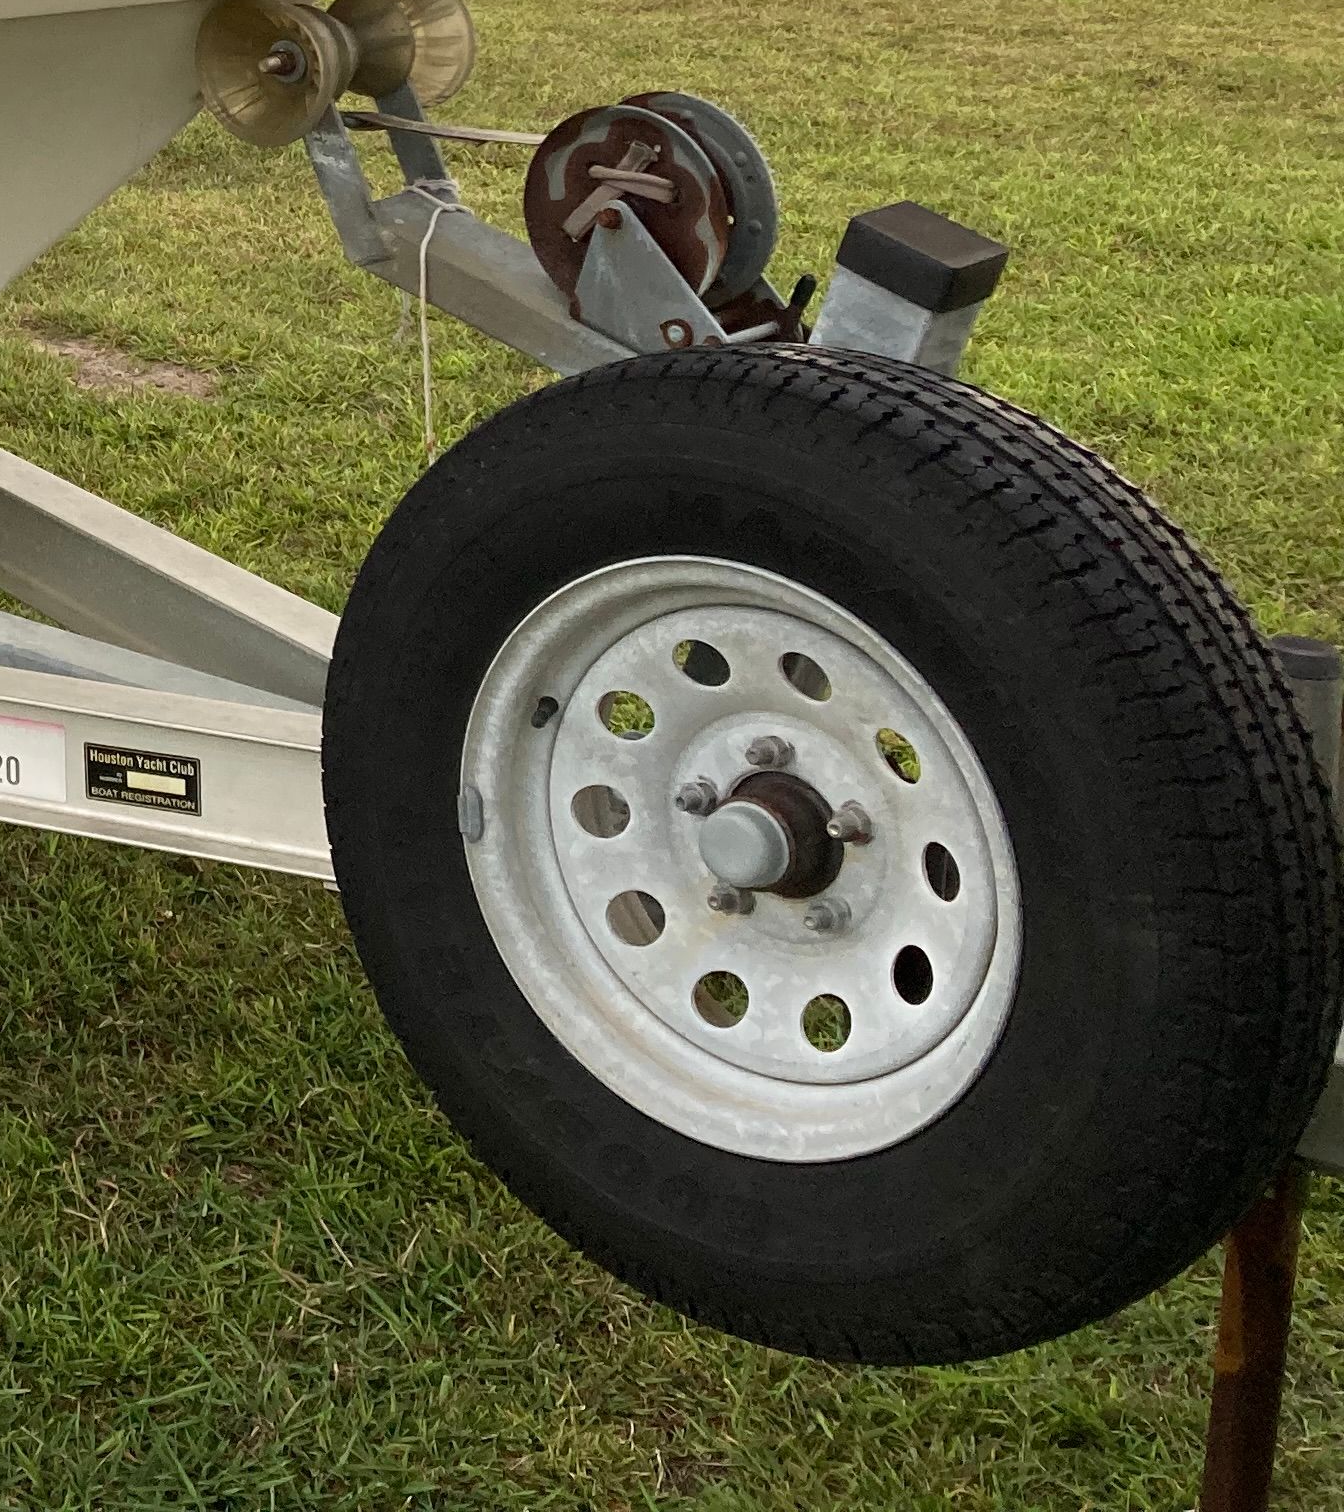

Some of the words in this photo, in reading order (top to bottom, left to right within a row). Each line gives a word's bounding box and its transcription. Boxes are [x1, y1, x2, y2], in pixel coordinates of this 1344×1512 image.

[89, 749, 134, 767] Houston
[136, 755, 167, 772] Yacht
[169, 760, 195, 776] Club
[91, 786, 119, 799] BOAT
[121, 790, 195, 810] REGISTRATION
